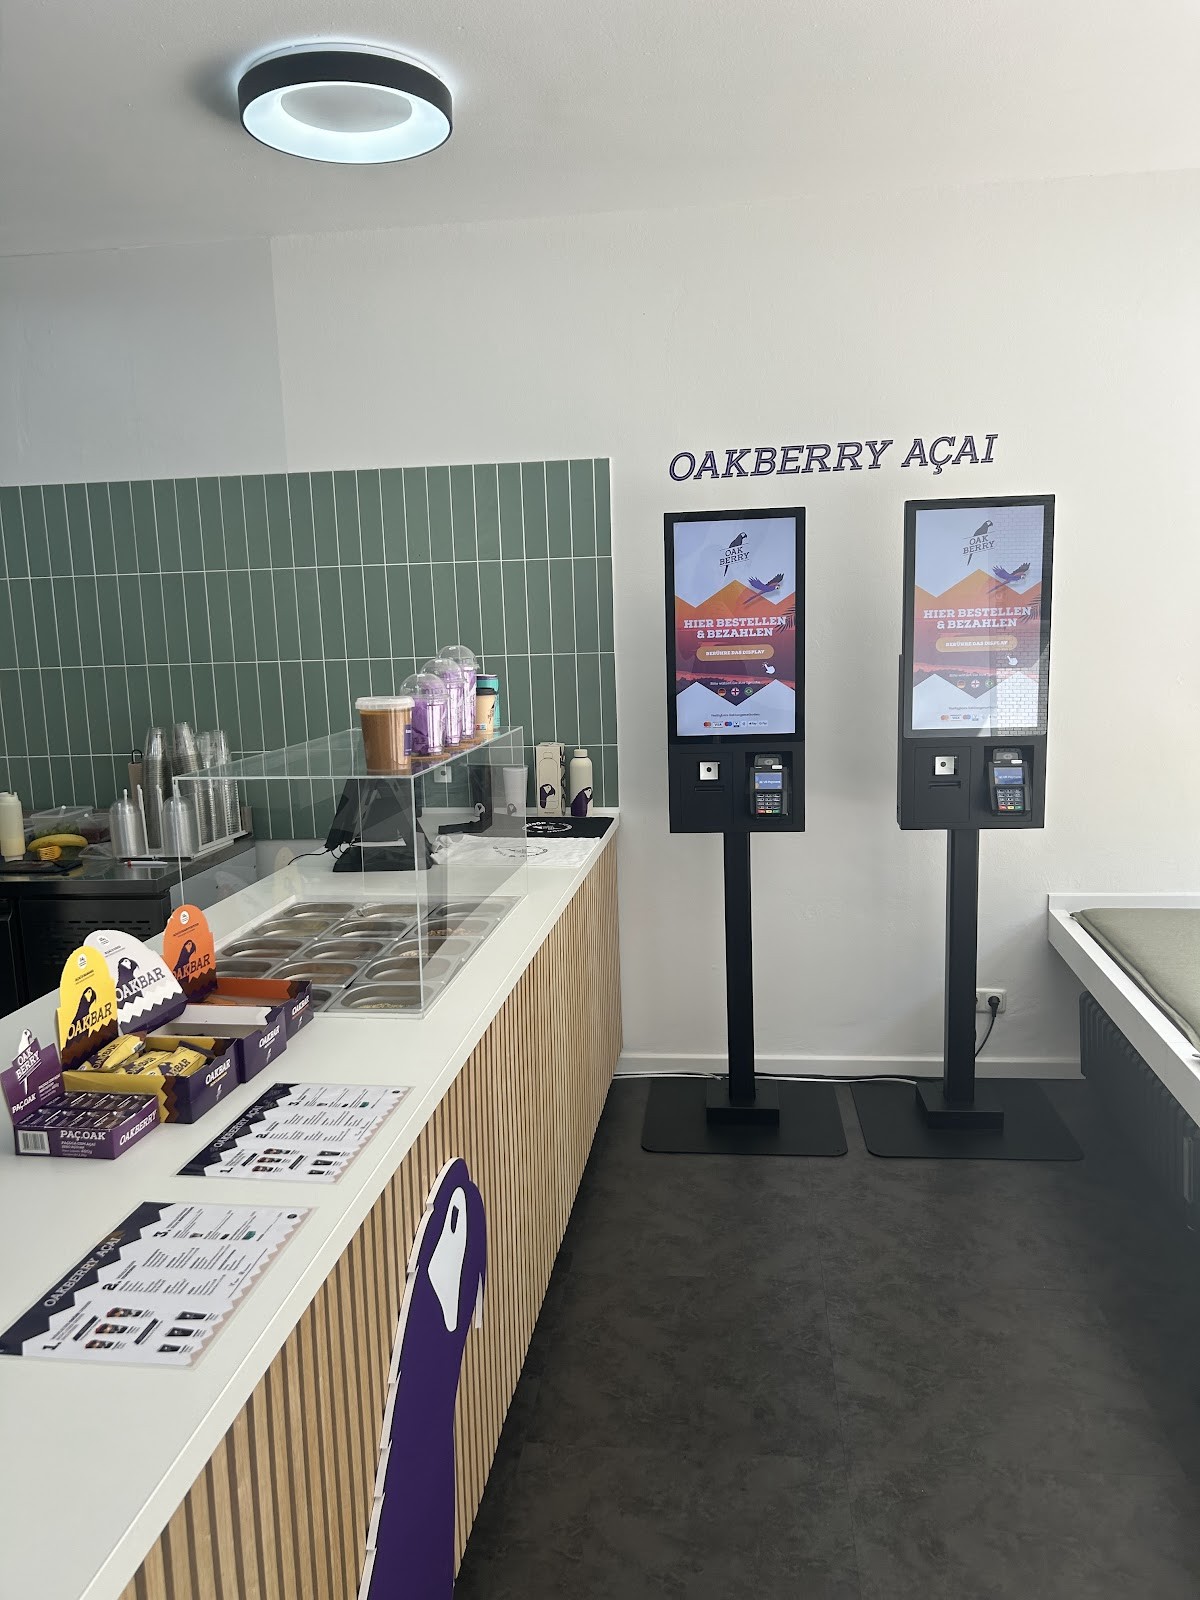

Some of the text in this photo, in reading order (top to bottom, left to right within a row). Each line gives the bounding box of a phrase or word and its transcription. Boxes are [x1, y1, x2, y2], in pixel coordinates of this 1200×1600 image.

[669, 433, 999, 481] OAKBERRY AÇAI
[962, 540, 995, 554] BERRY
[969, 534, 989, 546] OAK
[719, 551, 750, 566] BERRY
[725, 546, 744, 557] OAK
[684, 616, 787, 629] HIER BESTELLEN
[923, 606, 1032, 619] HIER BESTELLEN
[696, 628, 774, 639] & BEZAHLEN
[936, 618, 1018, 630] & BEZAHLEN
[116, 967, 166, 1002] OAKBAR
[291, 995, 310, 1016] OAKBAR
[67, 1002, 113, 1041] OAKBAR
[258, 1024, 280, 1049] OAKBAR
[15, 1050, 41, 1079] BERRY
[17, 1046, 33, 1065] OAK
[205, 1058, 231, 1086] OAKBAR
[119, 1108, 158, 1146] OAKBERRY
[213, 1115, 249, 1149] OAKBERRY
[43, 1256, 99, 1308] OAKBERRY
[96, 1235, 122, 1258] AÇAI
